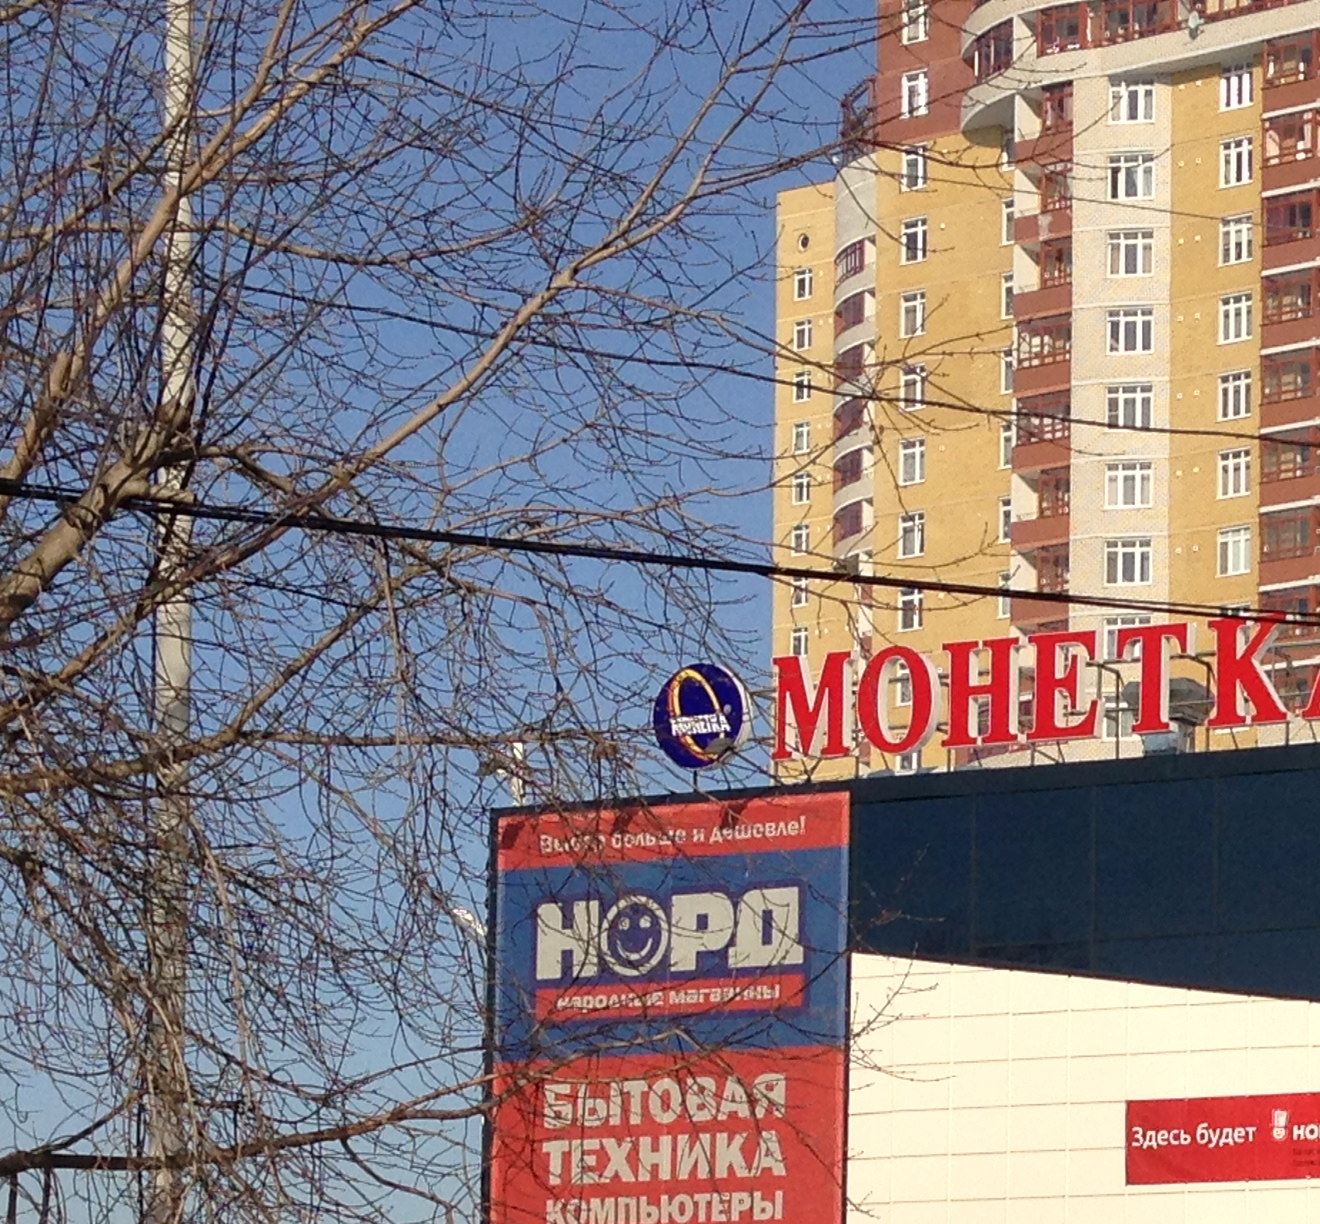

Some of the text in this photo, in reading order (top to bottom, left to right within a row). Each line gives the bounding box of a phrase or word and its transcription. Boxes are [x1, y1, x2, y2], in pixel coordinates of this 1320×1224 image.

[693, 830, 704, 843] и
[536, 886, 804, 981] НОРД
[542, 1072, 787, 1129] БЫТОВАЯ
[542, 1130, 787, 1187] ТЕХНИКА
[1131, 1126, 1191, 1149] Здесь
[1196, 1122, 1257, 1148] будет
